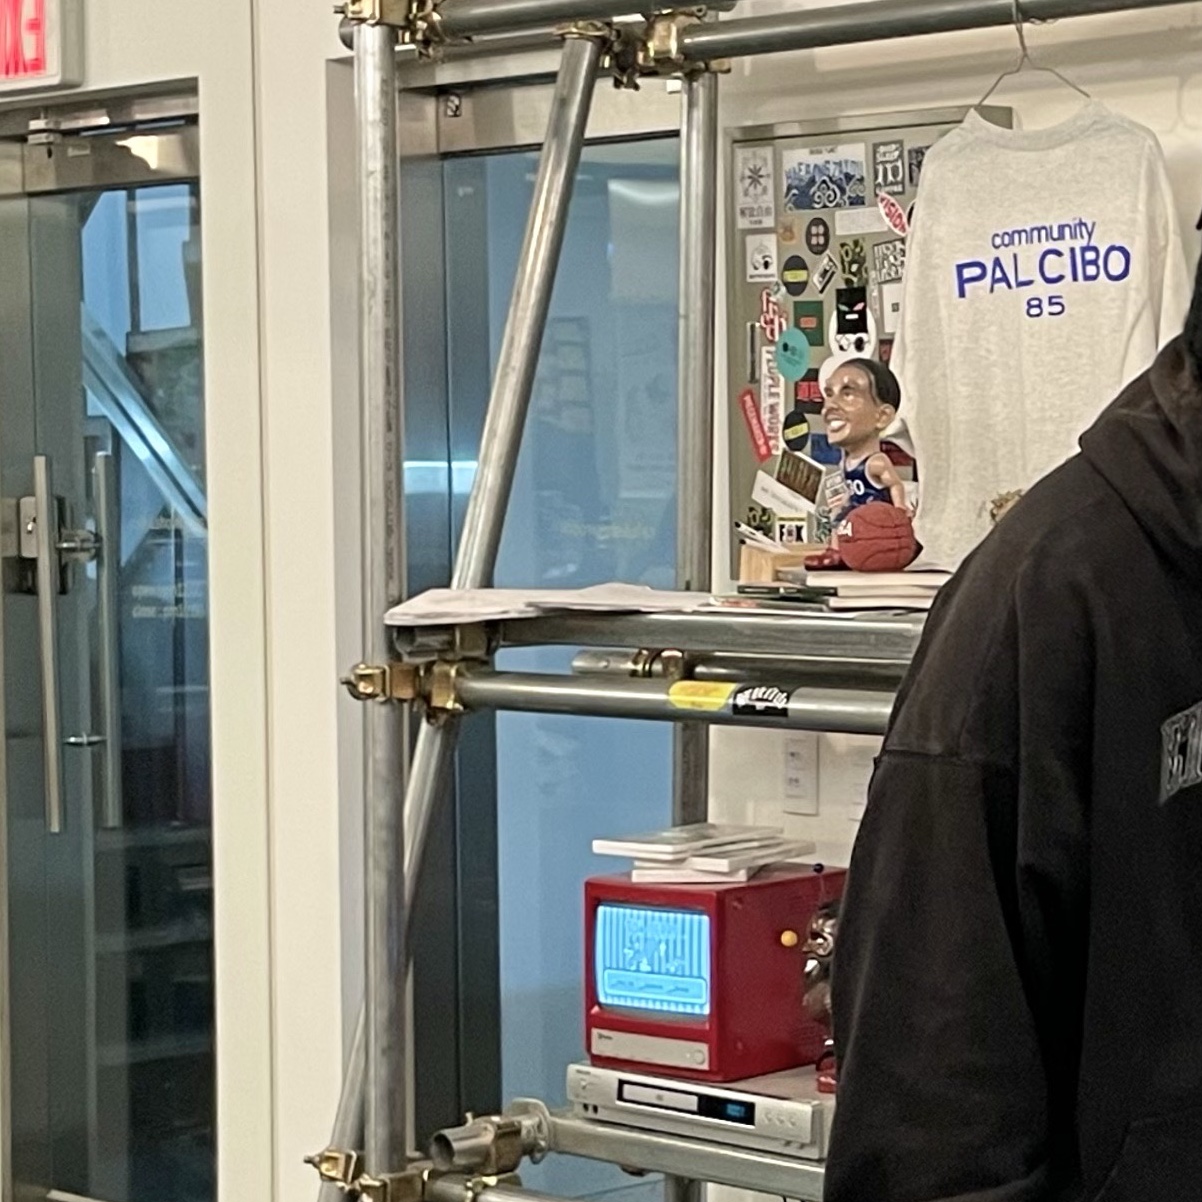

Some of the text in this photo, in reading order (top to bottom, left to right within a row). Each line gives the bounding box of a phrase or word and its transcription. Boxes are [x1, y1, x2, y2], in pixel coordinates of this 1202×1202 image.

[991, 217, 1096, 249] community
[955, 244, 1131, 299] PALCIBO
[1026, 295, 1066, 318] 85
